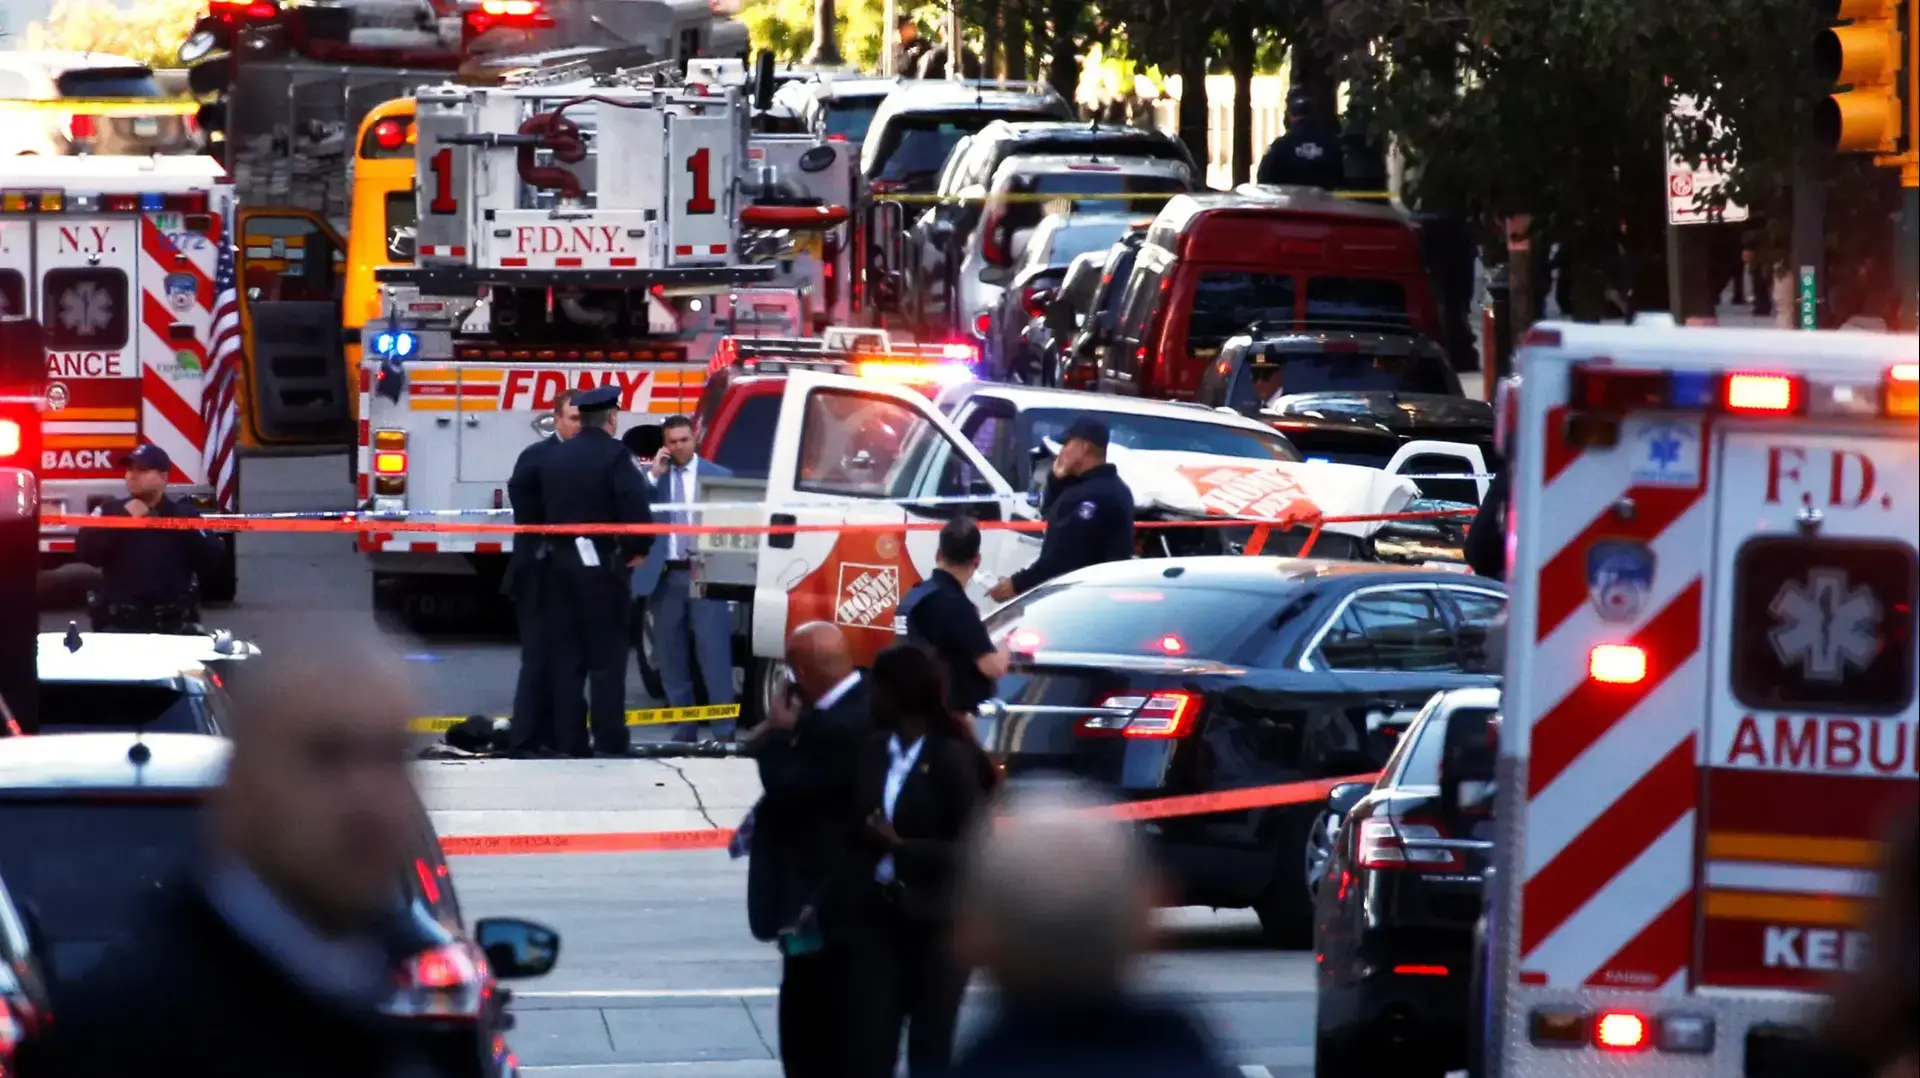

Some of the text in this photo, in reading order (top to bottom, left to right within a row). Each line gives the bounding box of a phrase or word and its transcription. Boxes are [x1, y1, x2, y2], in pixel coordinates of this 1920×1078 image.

[430, 148, 457, 215] 1
[686, 148, 716, 215] 1
[58, 226, 116, 253] N.Y.
[516, 225, 624, 253] F.D.N.Y.
[41, 449, 113, 470] BACK
[1764, 445, 1892, 510] F.D.
[838, 568, 897, 624] HOME
[846, 572, 872, 595] THE
[859, 591, 898, 626] DEPOT
